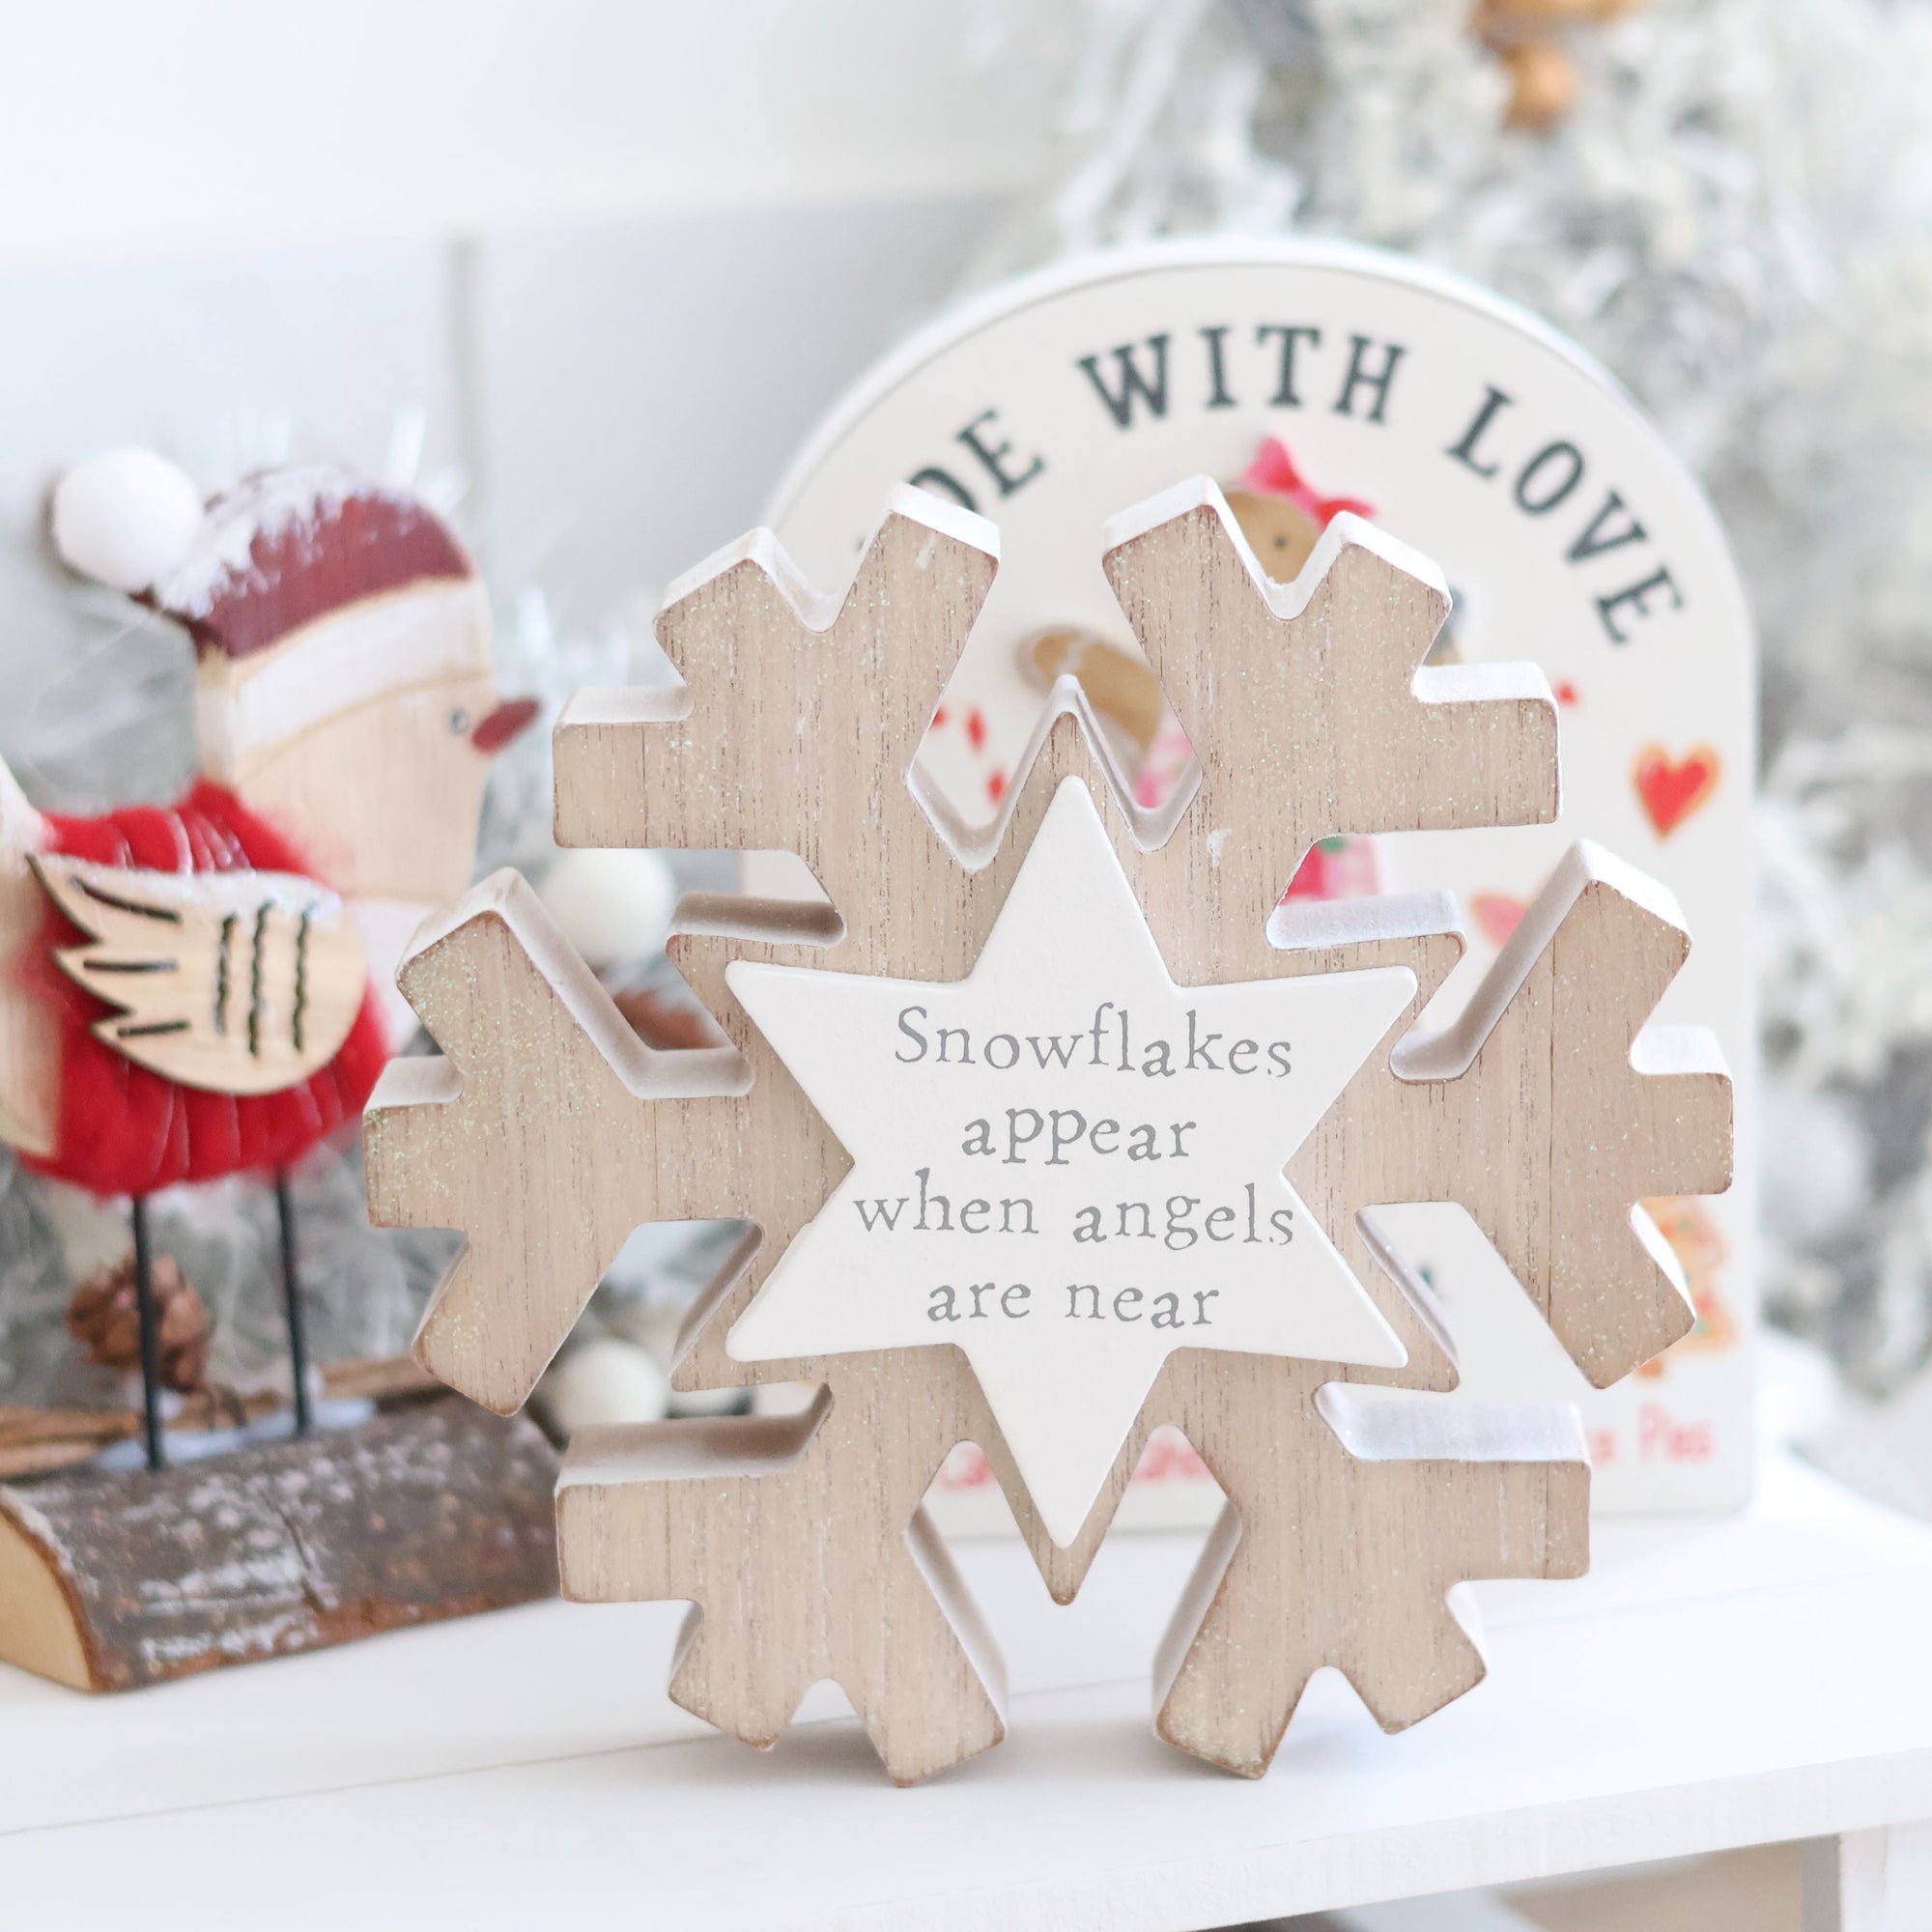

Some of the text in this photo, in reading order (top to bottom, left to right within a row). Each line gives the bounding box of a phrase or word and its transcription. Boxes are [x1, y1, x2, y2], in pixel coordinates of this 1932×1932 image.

[1076, 324, 1406, 430] WITH
[1445, 385, 1684, 644] LOVE
[895, 1001, 1293, 1078] Snowflakes
[960, 1107, 1197, 1166] appear
[852, 1167, 1293, 1251] when angels
[926, 1282, 1220, 1329] are near
